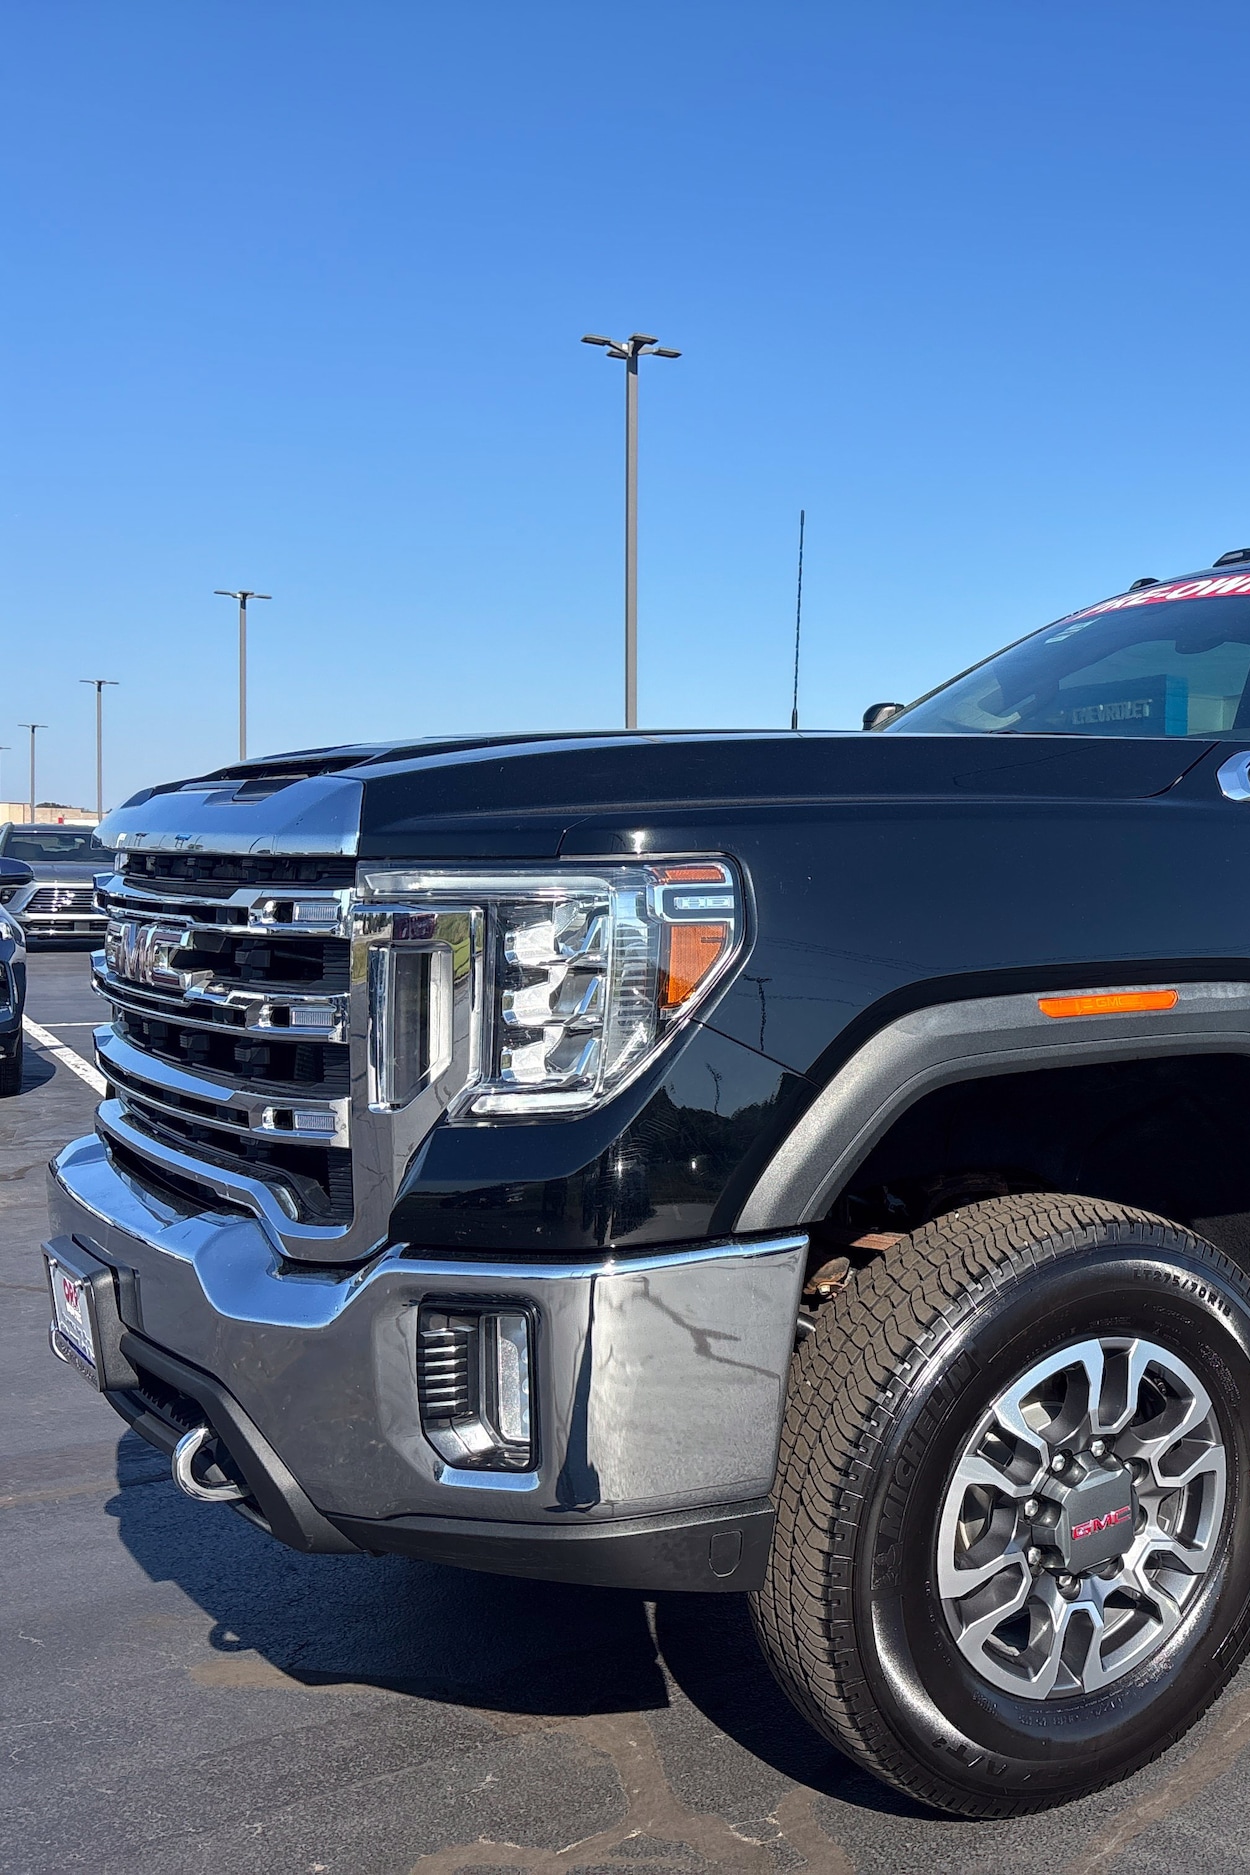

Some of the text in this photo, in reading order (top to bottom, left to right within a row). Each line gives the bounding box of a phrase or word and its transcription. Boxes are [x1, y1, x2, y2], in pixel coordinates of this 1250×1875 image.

[1072, 699, 1153, 725] CHEVROLET
[879, 1348, 976, 1542] MICHELIN
[1071, 1504, 1131, 1541] GMC
